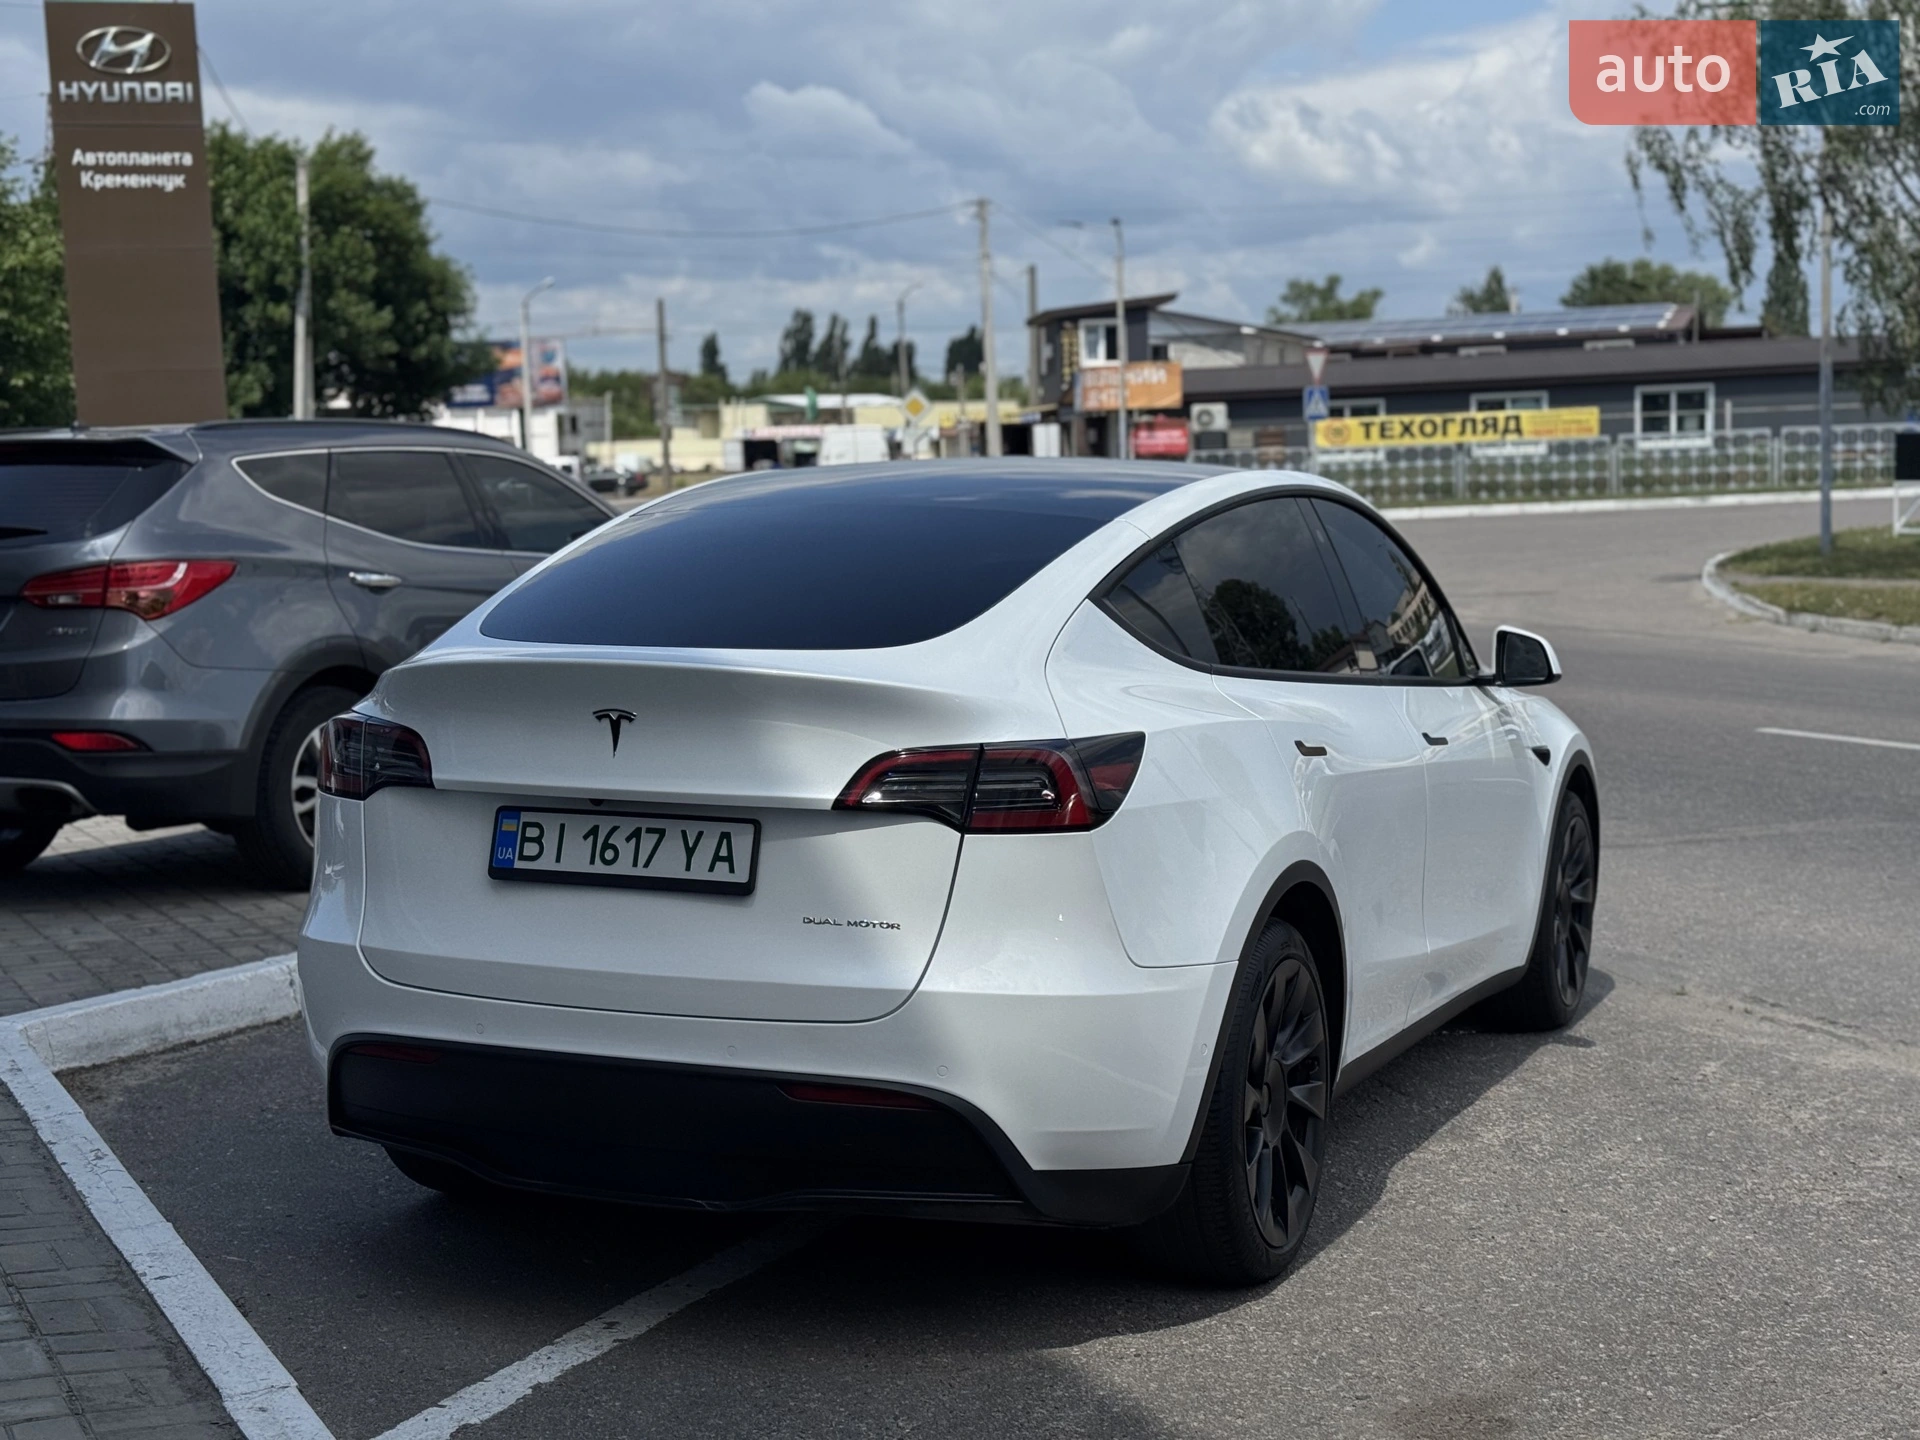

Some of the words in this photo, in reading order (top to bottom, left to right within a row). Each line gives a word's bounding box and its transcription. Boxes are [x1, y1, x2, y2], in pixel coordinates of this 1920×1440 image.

[58, 80, 194, 103] HYUNDAI
[71, 148, 194, 167] Автопланета
[80, 169, 187, 193] Кременчук
[1359, 414, 1524, 441] ТЕХОГЛЯД
[497, 846, 514, 861] UA
[517, 821, 567, 864] BI
[582, 824, 667, 869] 1617
[680, 829, 736, 875] YA
[802, 916, 843, 927] DUAL
[846, 919, 901, 931] MOTOR
